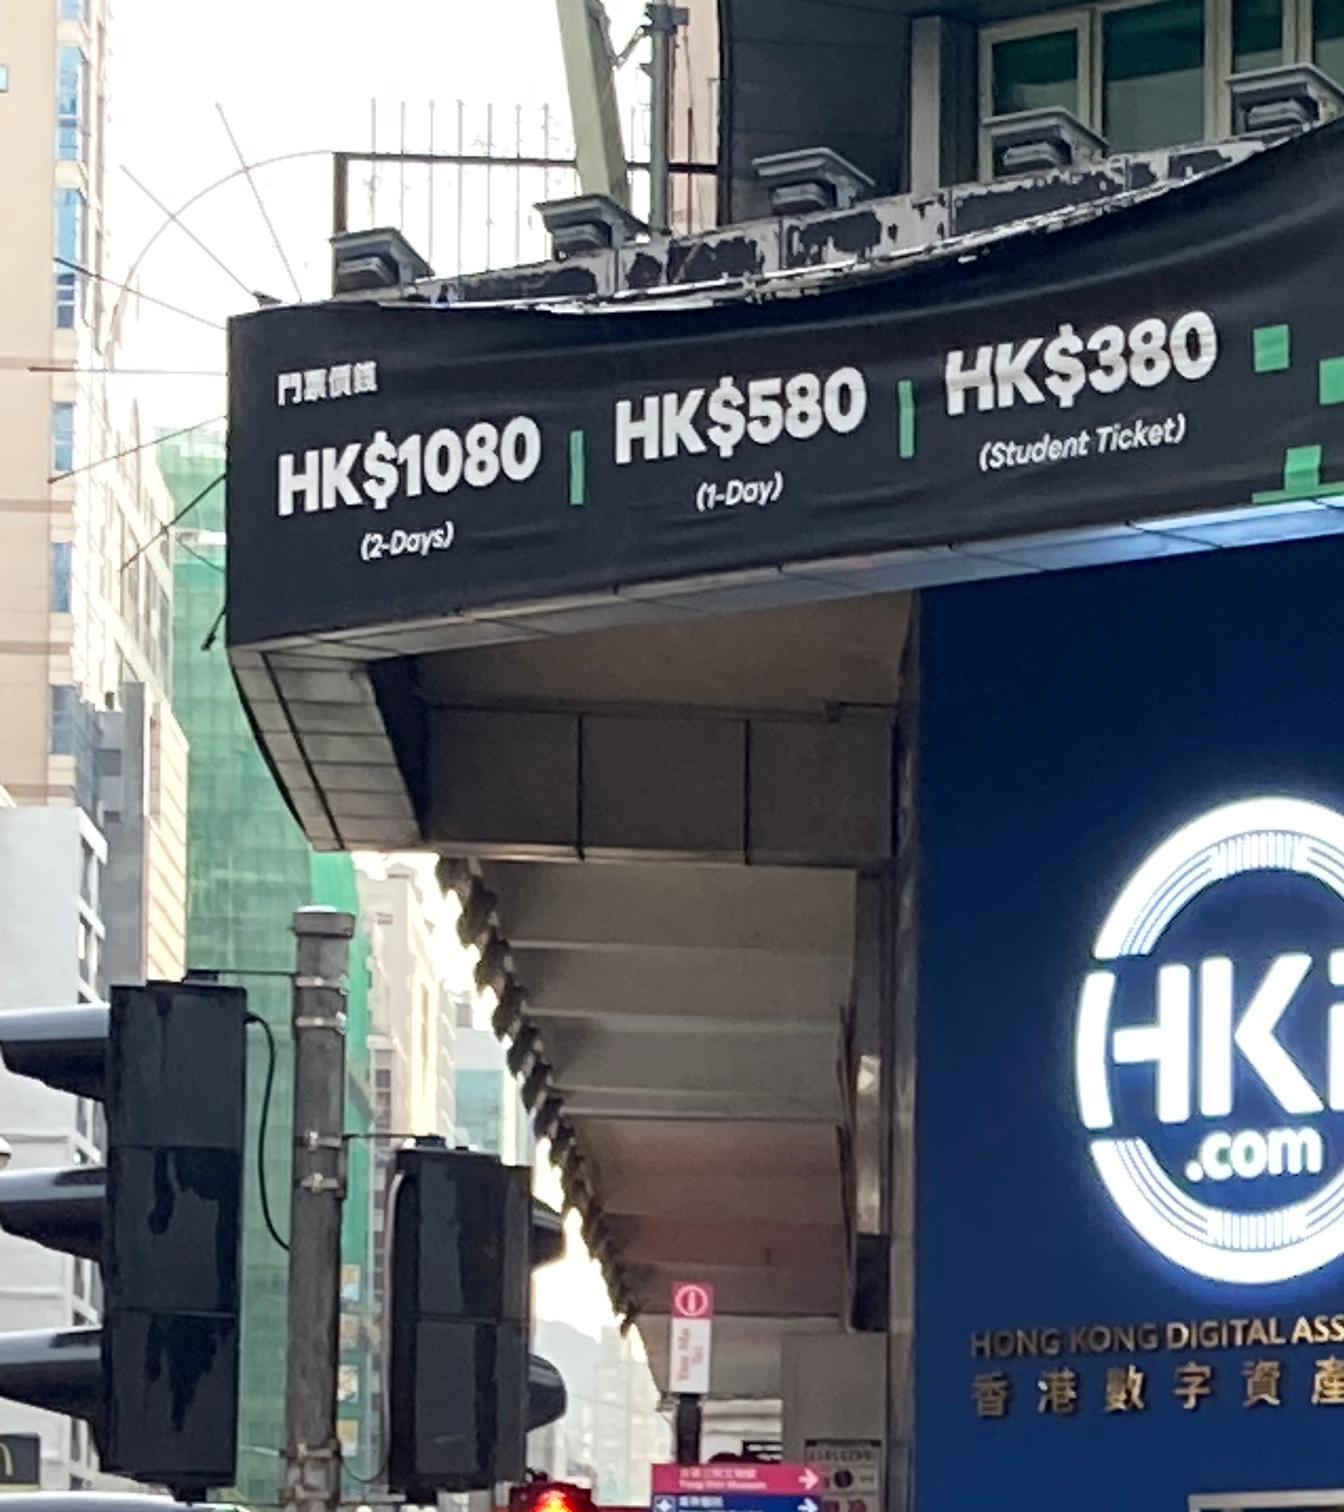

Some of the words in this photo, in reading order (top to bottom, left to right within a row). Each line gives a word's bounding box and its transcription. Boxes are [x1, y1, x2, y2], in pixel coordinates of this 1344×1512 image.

[944, 309, 1218, 420] HK$380
[614, 367, 868, 466] HK$580
[979, 427, 1088, 474] (Student
[1095, 412, 1186, 458] Ticket)
[277, 415, 542, 518] HK$1080
[695, 471, 783, 513] (1-Day)
[360, 520, 455, 562] (2-Days)
[1184, 1125, 1323, 1183] .com
[969, 1325, 1060, 1359] HONG
[1068, 1321, 1158, 1355] KONG
[1165, 1317, 1286, 1351] DIGITAL
